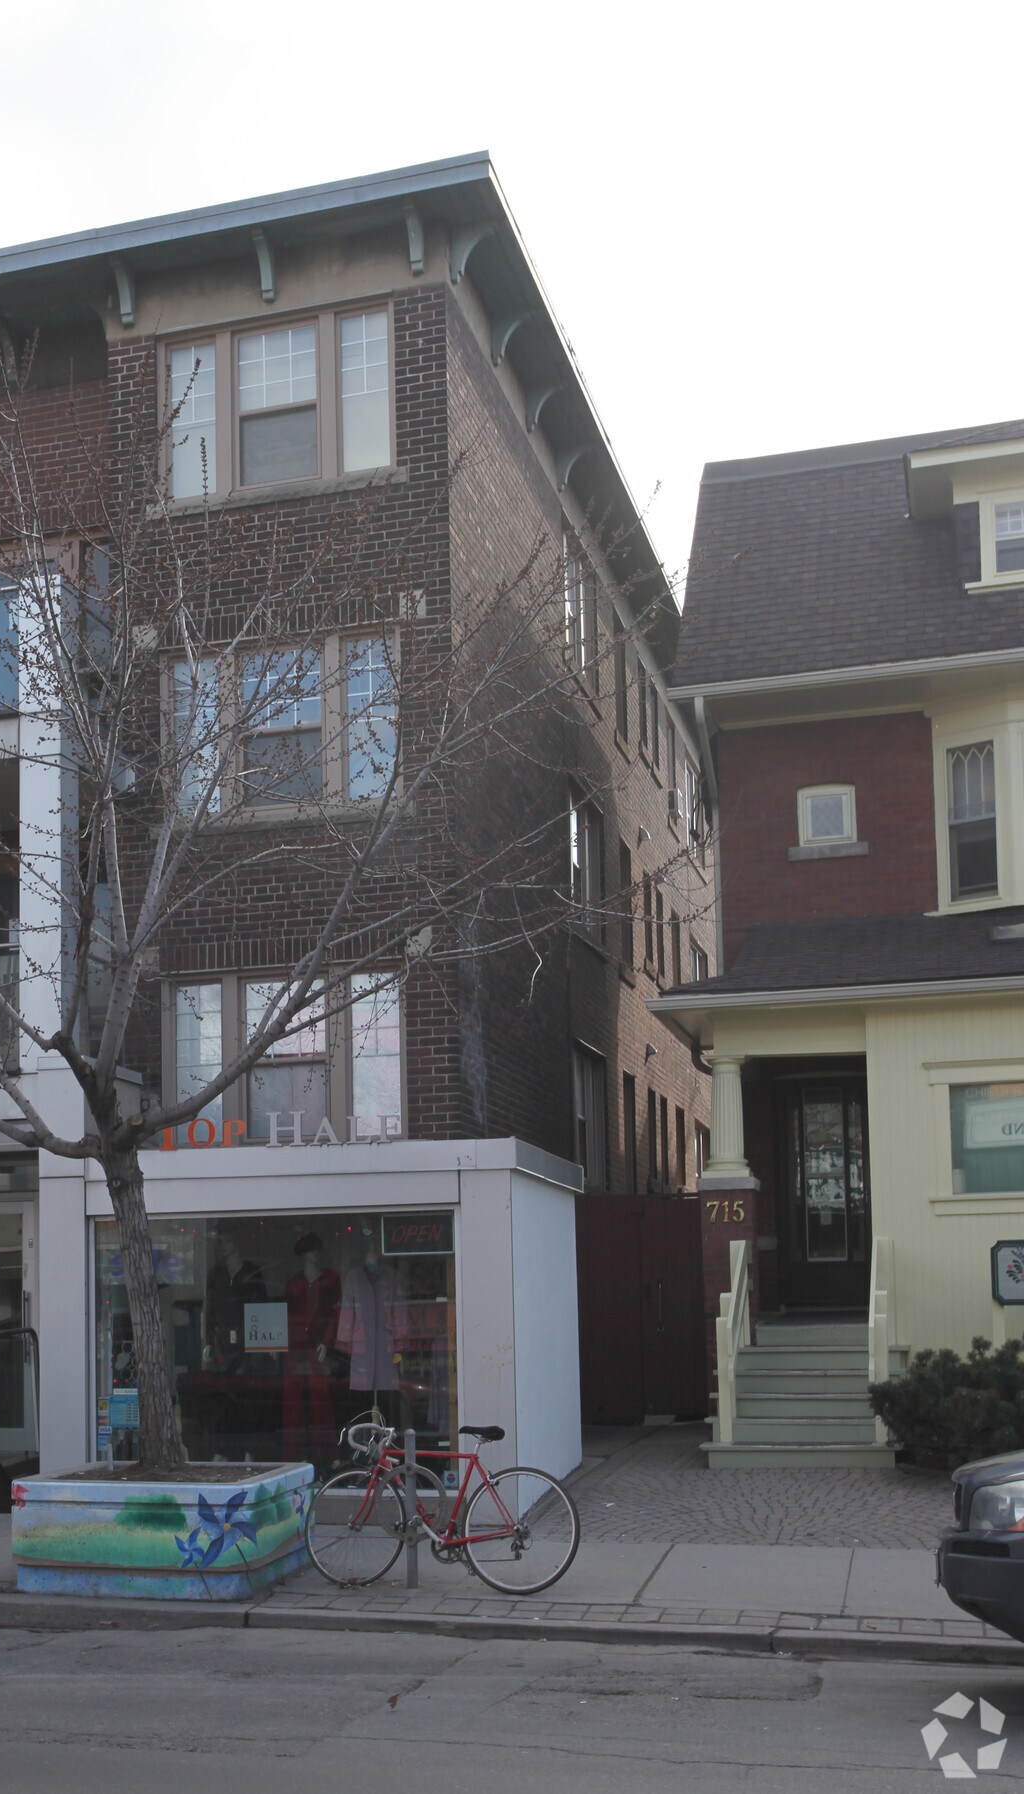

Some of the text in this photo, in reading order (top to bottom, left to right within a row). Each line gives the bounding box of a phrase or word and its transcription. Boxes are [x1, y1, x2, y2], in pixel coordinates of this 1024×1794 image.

[266, 1110, 401, 1147] HALF
[706, 1200, 745, 1224] 715
[391, 1223, 443, 1245] OPEN
[111, 1248, 181, 1278] sle
